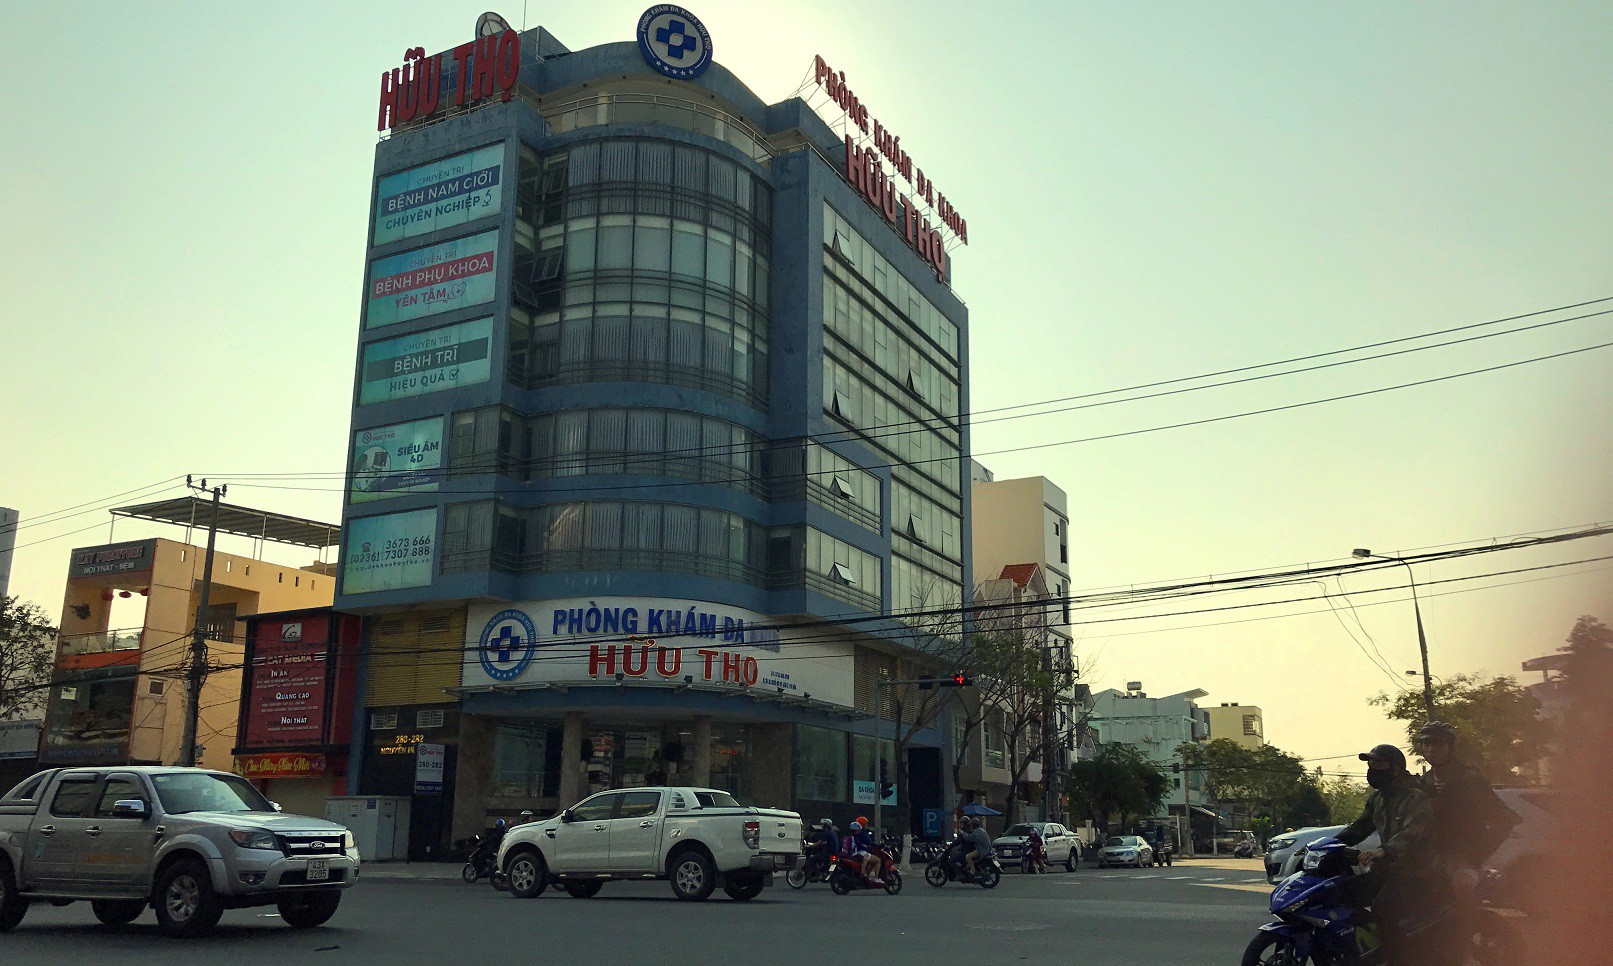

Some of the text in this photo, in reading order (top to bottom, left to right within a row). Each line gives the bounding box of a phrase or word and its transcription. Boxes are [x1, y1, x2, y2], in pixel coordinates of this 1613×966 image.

[378, 29, 520, 131] HỮU THỌ
[815, 54, 869, 135] PHÒNG
[874, 118, 912, 184] KHÁM
[938, 192, 968, 246] KHOA
[388, 170, 492, 211] BỆNH NAM GIỚI
[385, 194, 480, 230] CHUYÊN NGHIỆP
[845, 134, 947, 284] HỮU THỌ
[375, 257, 489, 295] BỆNH PHỤ KHOA
[395, 287, 447, 308] YÊN TÂM
[394, 345, 459, 374] BỆNH TRĨ
[390, 369, 446, 393] HIỆU QUẢ
[398, 440, 440, 456] SIÊU ÂM
[410, 453, 424, 464] 4D
[350, 545, 431, 565] (0236) 7307 888
[385, 535, 431, 550] 3673 666
[553, 601, 638, 635] PHÒNG
[647, 605, 717, 639] KHÁM
[926, 811, 937, 828] P
[312, 860, 326, 869] 43X
